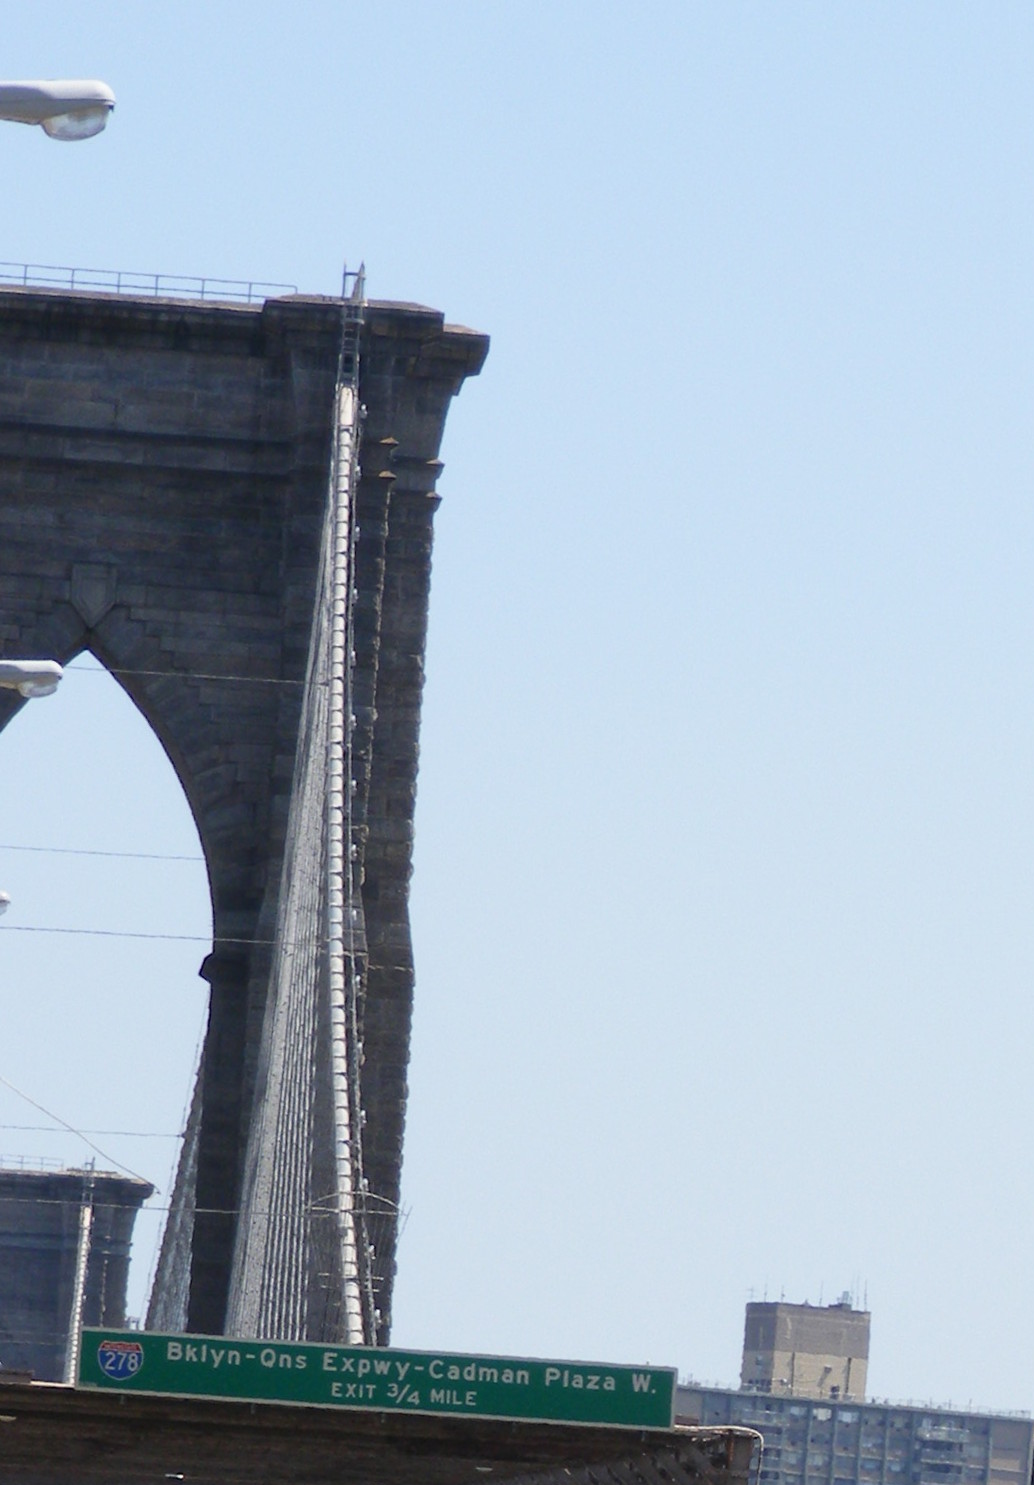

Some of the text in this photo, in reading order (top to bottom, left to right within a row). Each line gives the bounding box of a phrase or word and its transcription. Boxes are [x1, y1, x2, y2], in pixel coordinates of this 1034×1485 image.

[104, 1351, 139, 1372] 278
[166, 1341, 657, 1394] Bklyn-Qns Expwy-Cadman Plaza W.
[331, 1382, 376, 1398] EXIT
[430, 1388, 477, 1406] MILE
